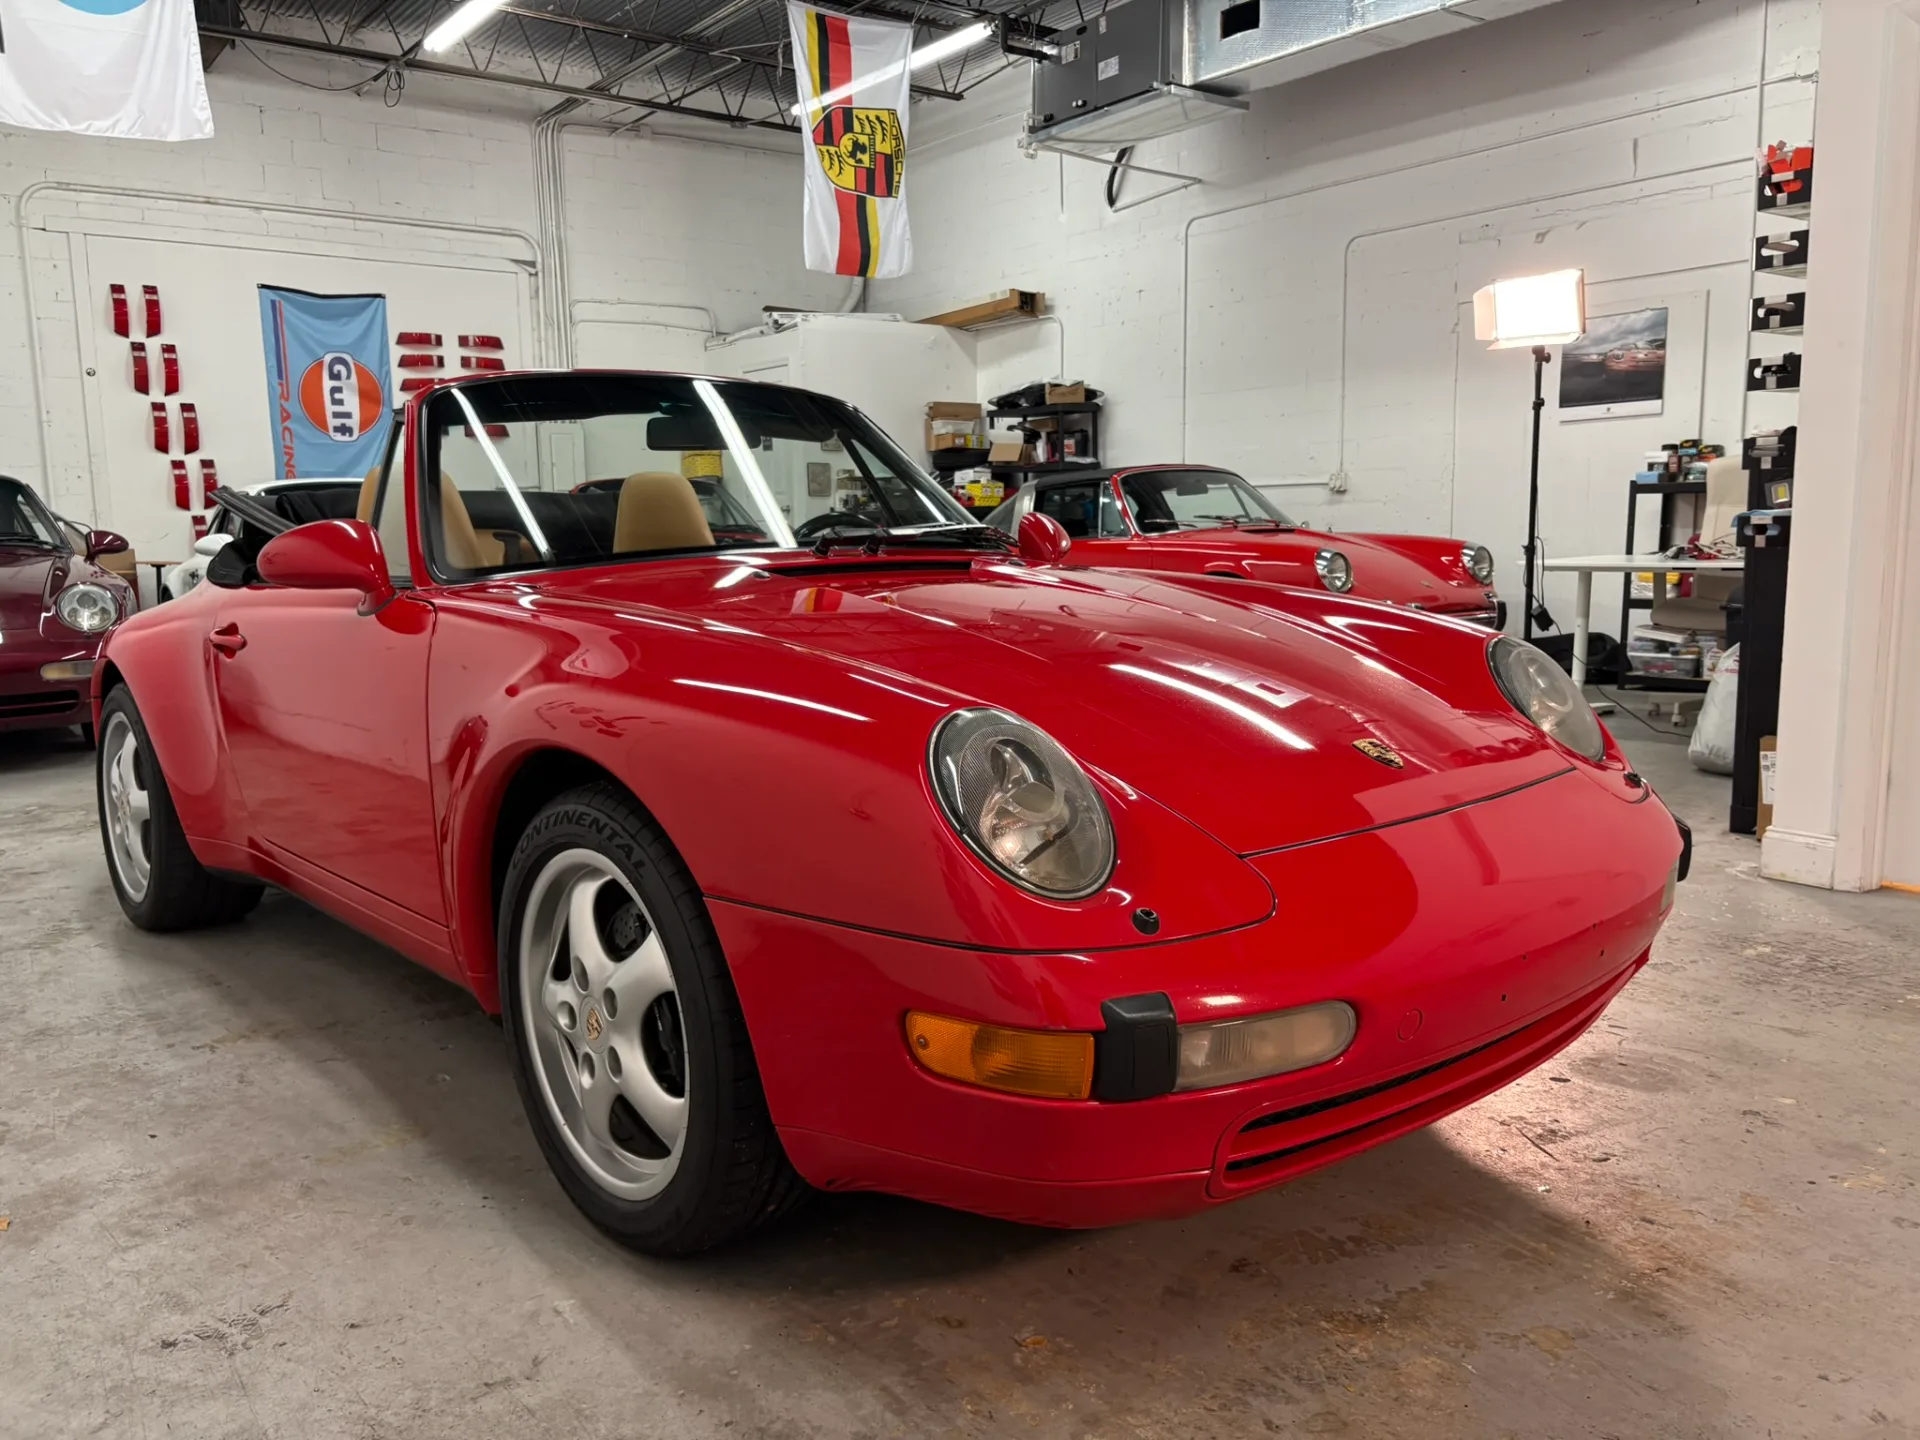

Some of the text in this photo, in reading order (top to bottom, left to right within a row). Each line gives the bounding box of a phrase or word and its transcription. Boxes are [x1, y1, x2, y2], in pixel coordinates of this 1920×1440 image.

[890, 112, 904, 195] PORSCHE
[328, 356, 354, 438] Gulf
[512, 810, 646, 879] CONTINENTAL
